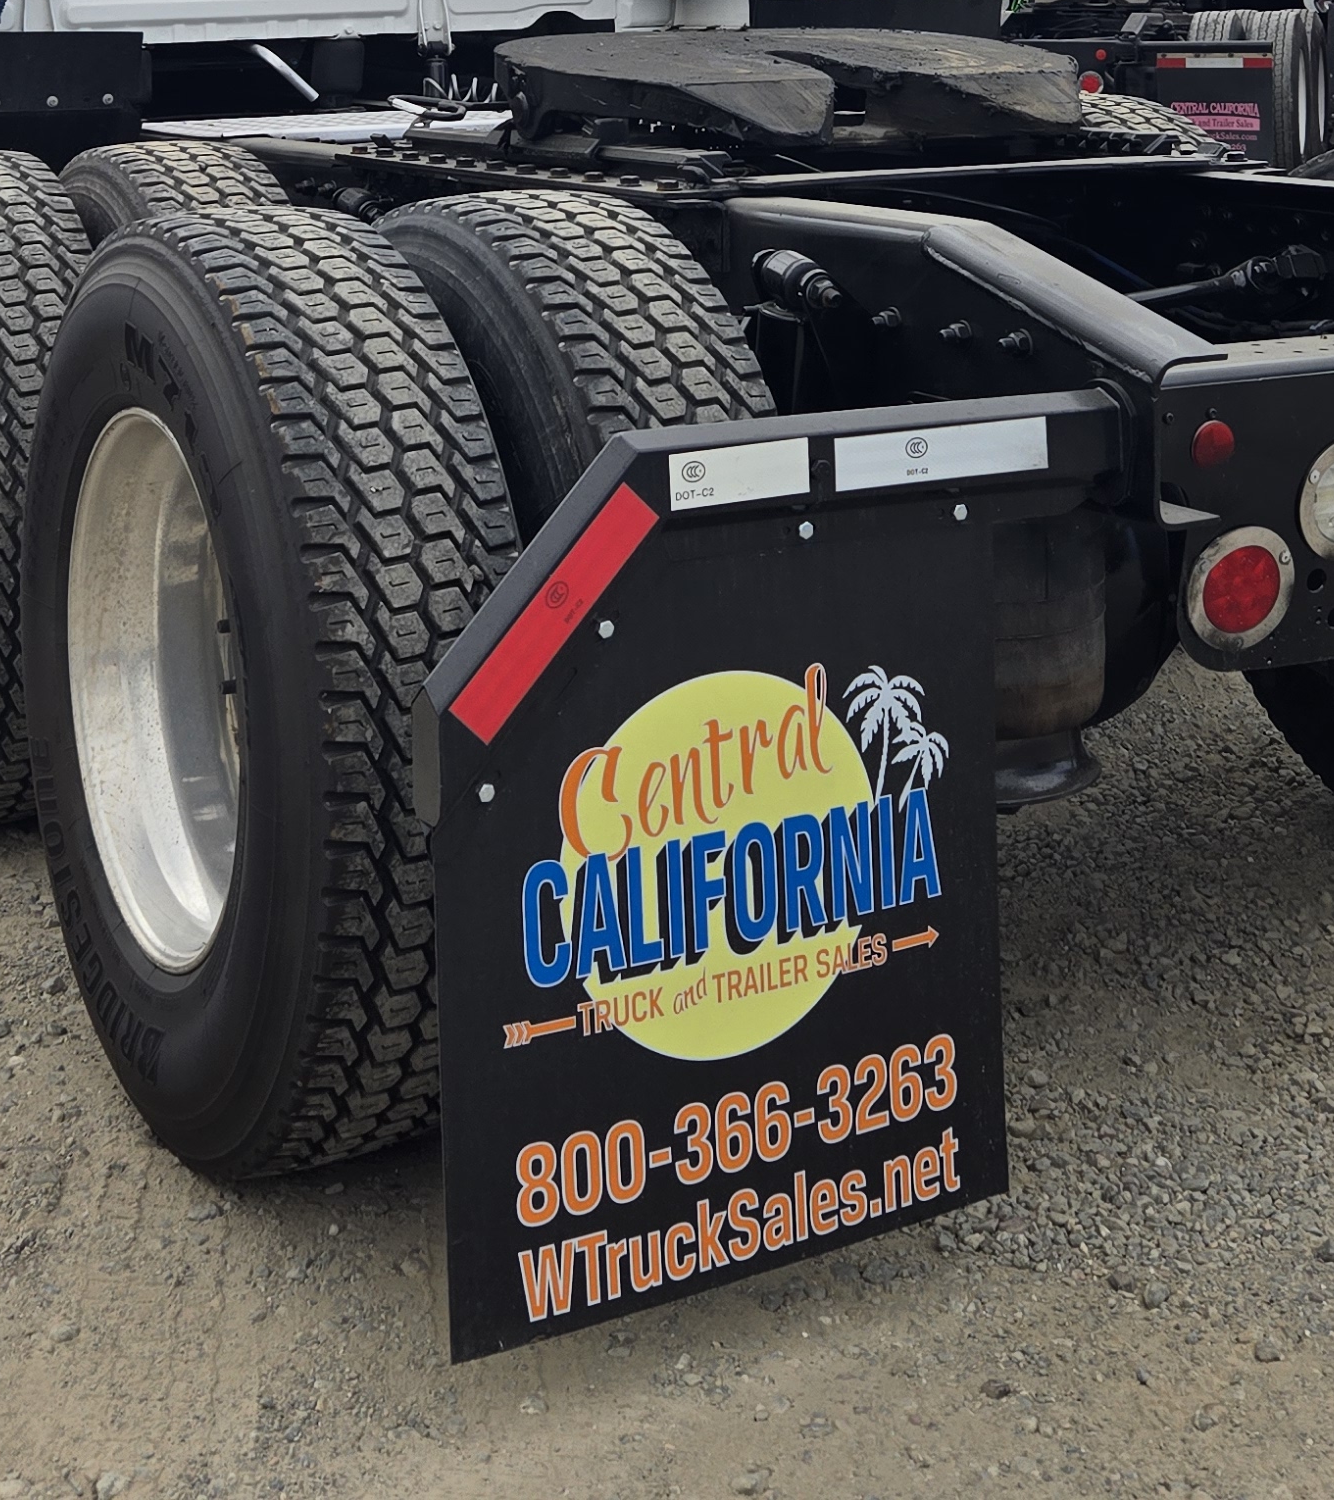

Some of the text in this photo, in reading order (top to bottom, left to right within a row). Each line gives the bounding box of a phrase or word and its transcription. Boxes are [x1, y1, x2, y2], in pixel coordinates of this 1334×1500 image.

[1171, 102, 1260, 117] CENTRAL CALIFORNIA
[1212, 118, 1235, 128] Trailer
[1236, 119, 1254, 128] Sales
[675, 487, 715, 501] DOT-C2
[906, 467, 929, 476] DOT-C2
[559, 663, 834, 862] Central
[521, 787, 942, 988] CALIFORNIA
[577, 933, 887, 1037] TRUCK and TRAILER SALES
[515, 1033, 958, 1227] 800-366-3263
[518, 1127, 961, 1322] WTruckSales.net
